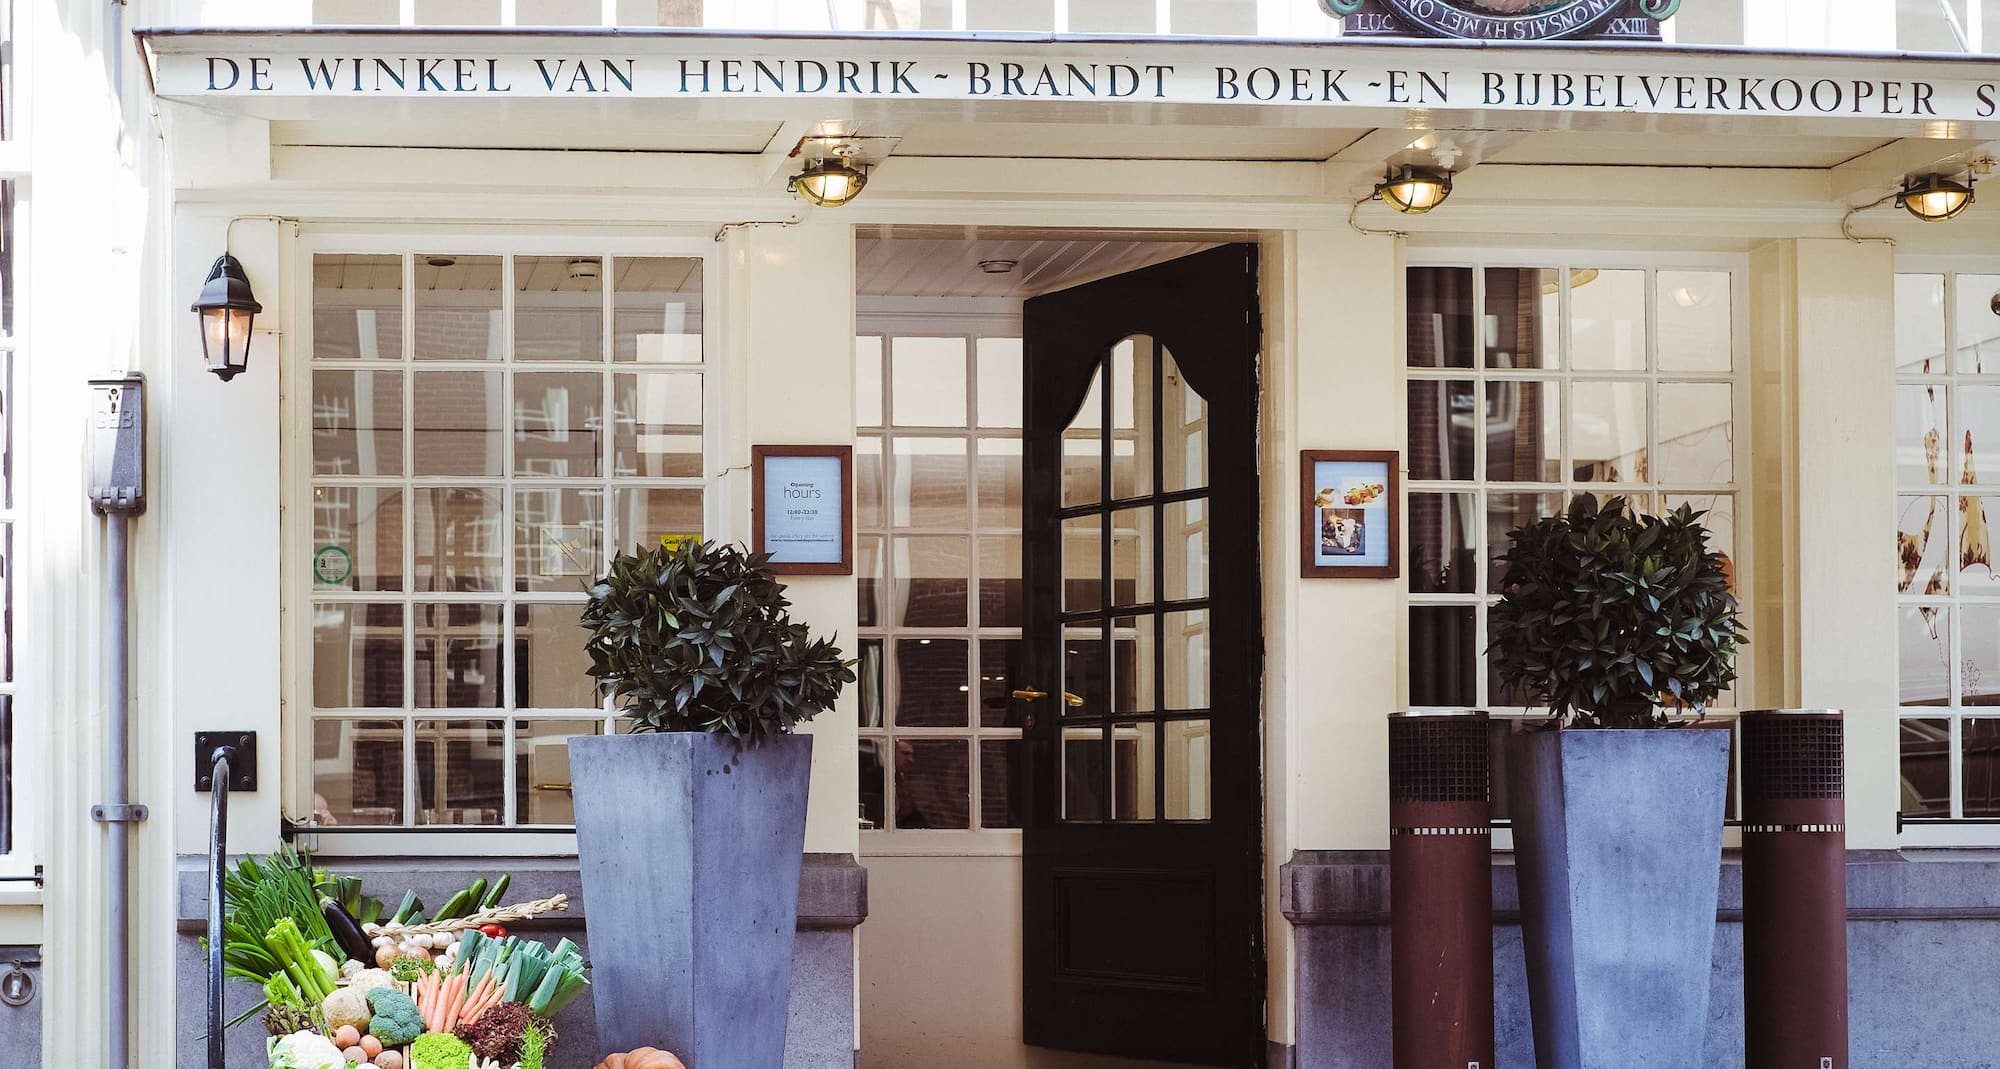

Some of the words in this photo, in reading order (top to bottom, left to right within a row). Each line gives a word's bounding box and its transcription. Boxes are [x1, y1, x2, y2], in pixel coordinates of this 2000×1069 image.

[1355, 12, 1396, 30] LUC
[1435, 7, 1480, 34] MET
[205, 57, 272, 91] DE
[297, 58, 511, 92] WINKEL
[533, 59, 634, 93] VAN
[677, 61, 920, 94] HENDRIK
[966, 63, 1174, 98] BRANDT
[1215, 67, 1350, 103] BOEK
[1481, 72, 1937, 115] BIJBELVERKOOPER
[1976, 83, 1996, 117] S
[784, 486, 821, 498] hours
